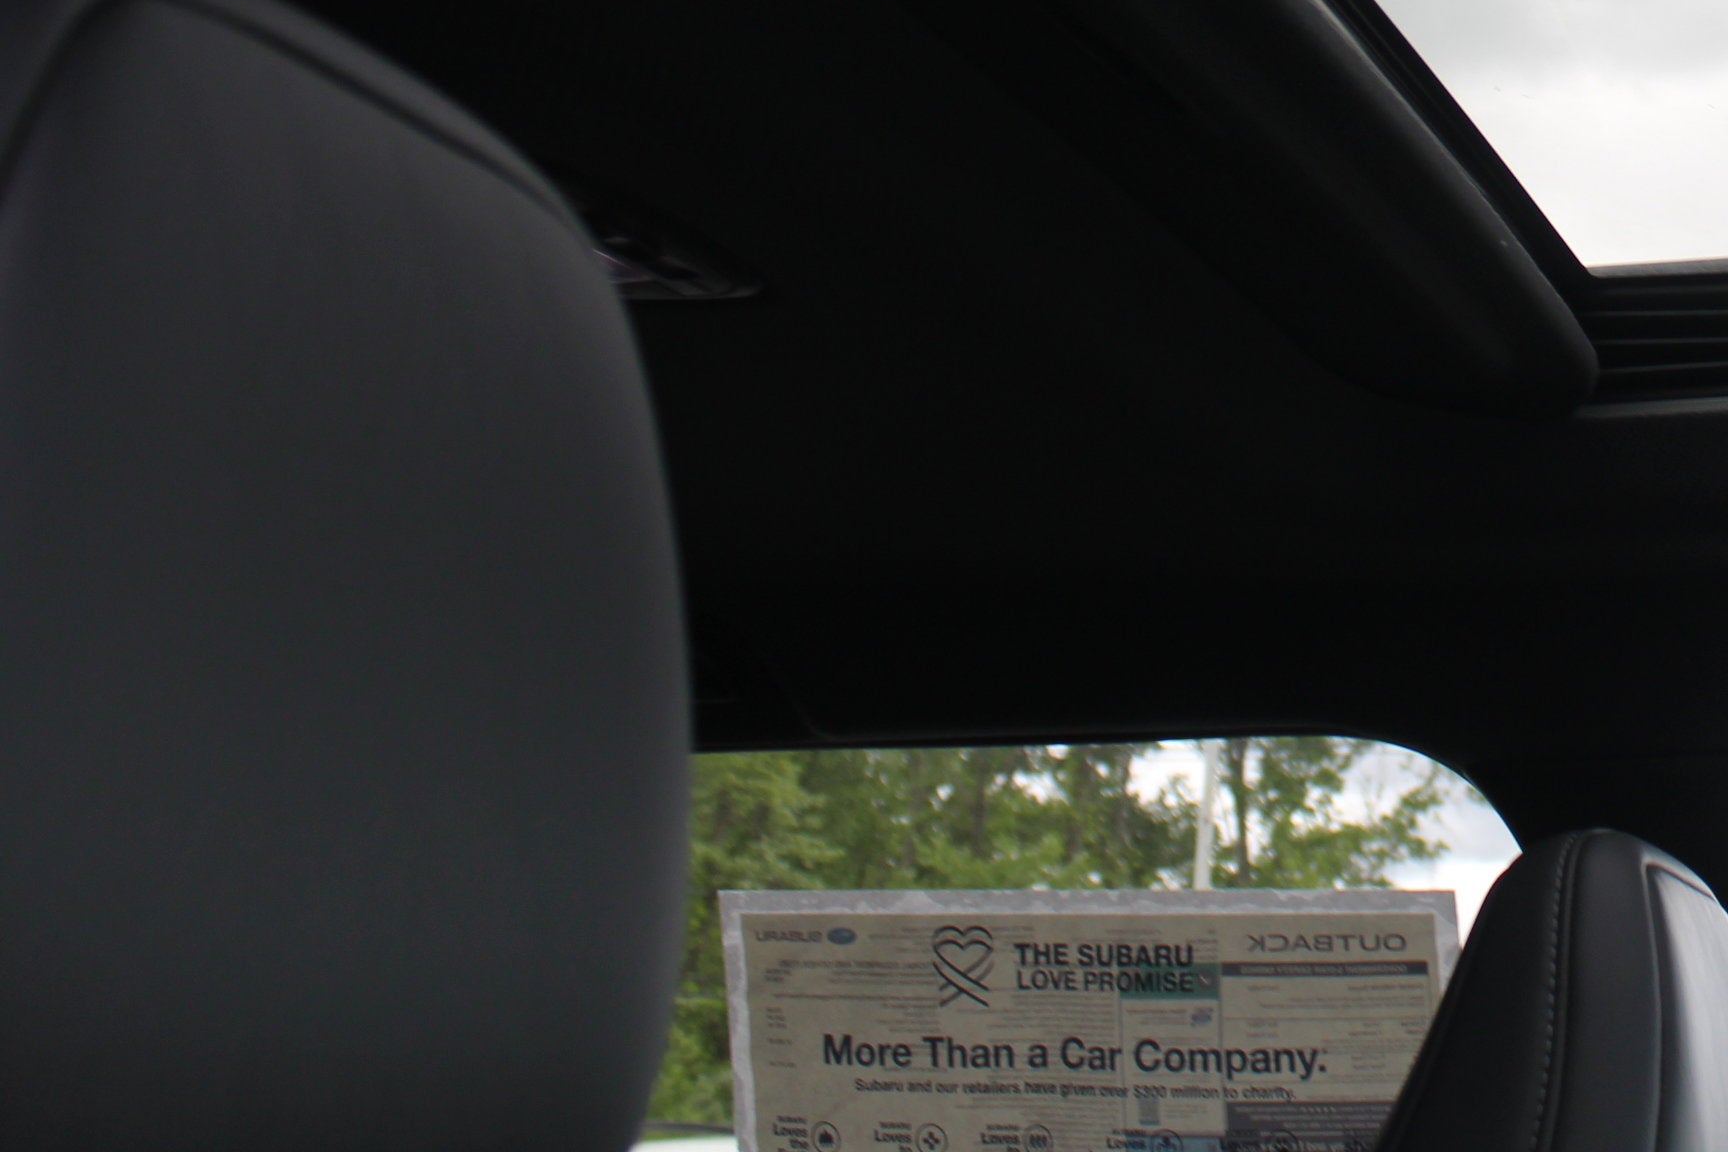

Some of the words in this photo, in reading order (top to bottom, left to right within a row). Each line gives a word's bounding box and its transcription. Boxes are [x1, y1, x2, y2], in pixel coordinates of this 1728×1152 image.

[1013, 943, 1070, 966] THE
[1077, 944, 1194, 967] SUBARU
[1017, 970, 1078, 991] LOVE
[1084, 971, 1196, 993] PROMISE
[823, 1034, 912, 1067] More
[922, 1036, 1015, 1069] Than
[1028, 1044, 1049, 1068] a
[1061, 1036, 1122, 1071] Car
[1134, 1038, 1328, 1080] Company.
[855, 1078, 904, 1092] Subaru
[907, 1079, 933, 1093] and
[936, 1082, 958, 1093] our
[962, 1081, 1021, 1094] retailers
[1024, 1081, 1058, 1094] have
[1060, 1083, 1096, 1098] given
[1100, 1086, 1128, 1098] over
[1170, 1086, 1218, 1099] million
[1223, 1087, 1238, 1098] to
[773, 1122, 808, 1138] Loves
[874, 1130, 912, 1143] Loves
